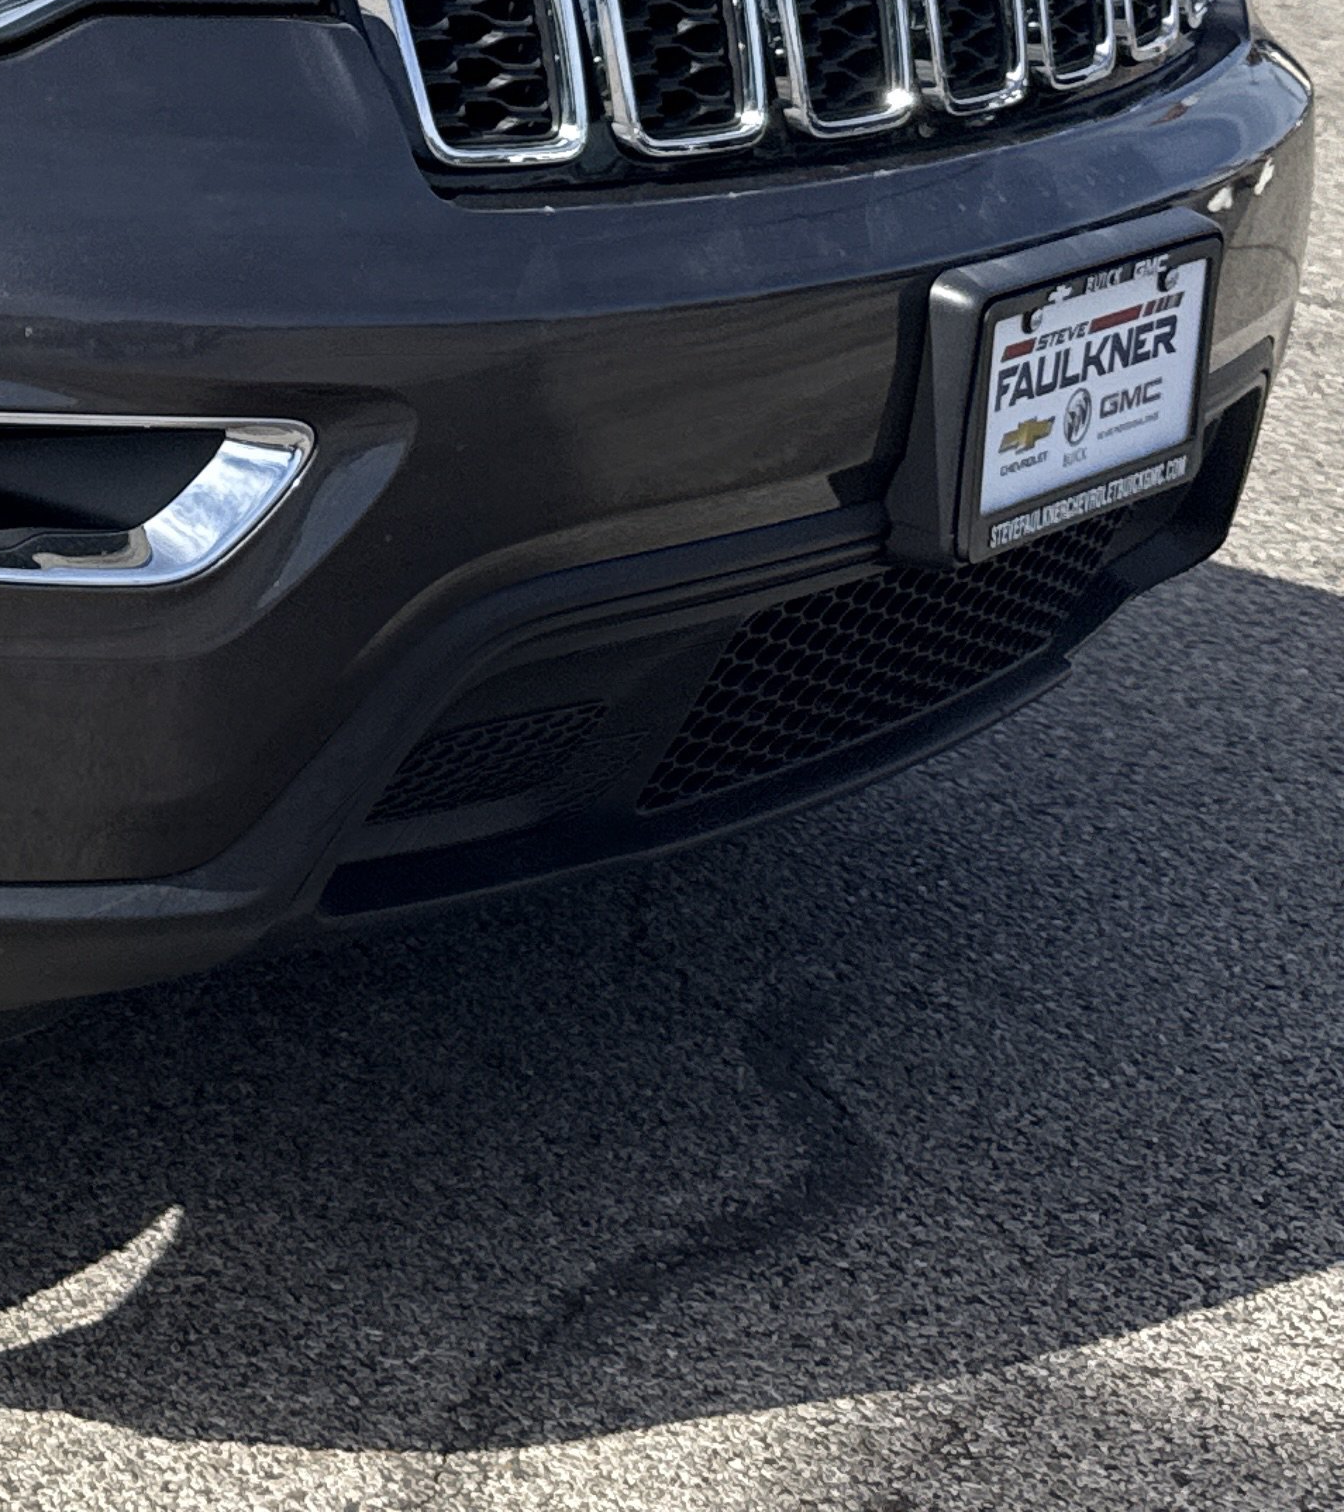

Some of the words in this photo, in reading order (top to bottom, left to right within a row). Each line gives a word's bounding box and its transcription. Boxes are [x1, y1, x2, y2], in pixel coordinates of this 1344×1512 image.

[1084, 268, 1123, 294] BUICK
[1133, 254, 1170, 279] GMC
[1034, 320, 1088, 351] STEVE
[994, 315, 1178, 412] FAULKNER
[1099, 377, 1163, 419] GMC
[1000, 450, 1049, 477] CHEVROLET
[1062, 447, 1088, 468] BUICK
